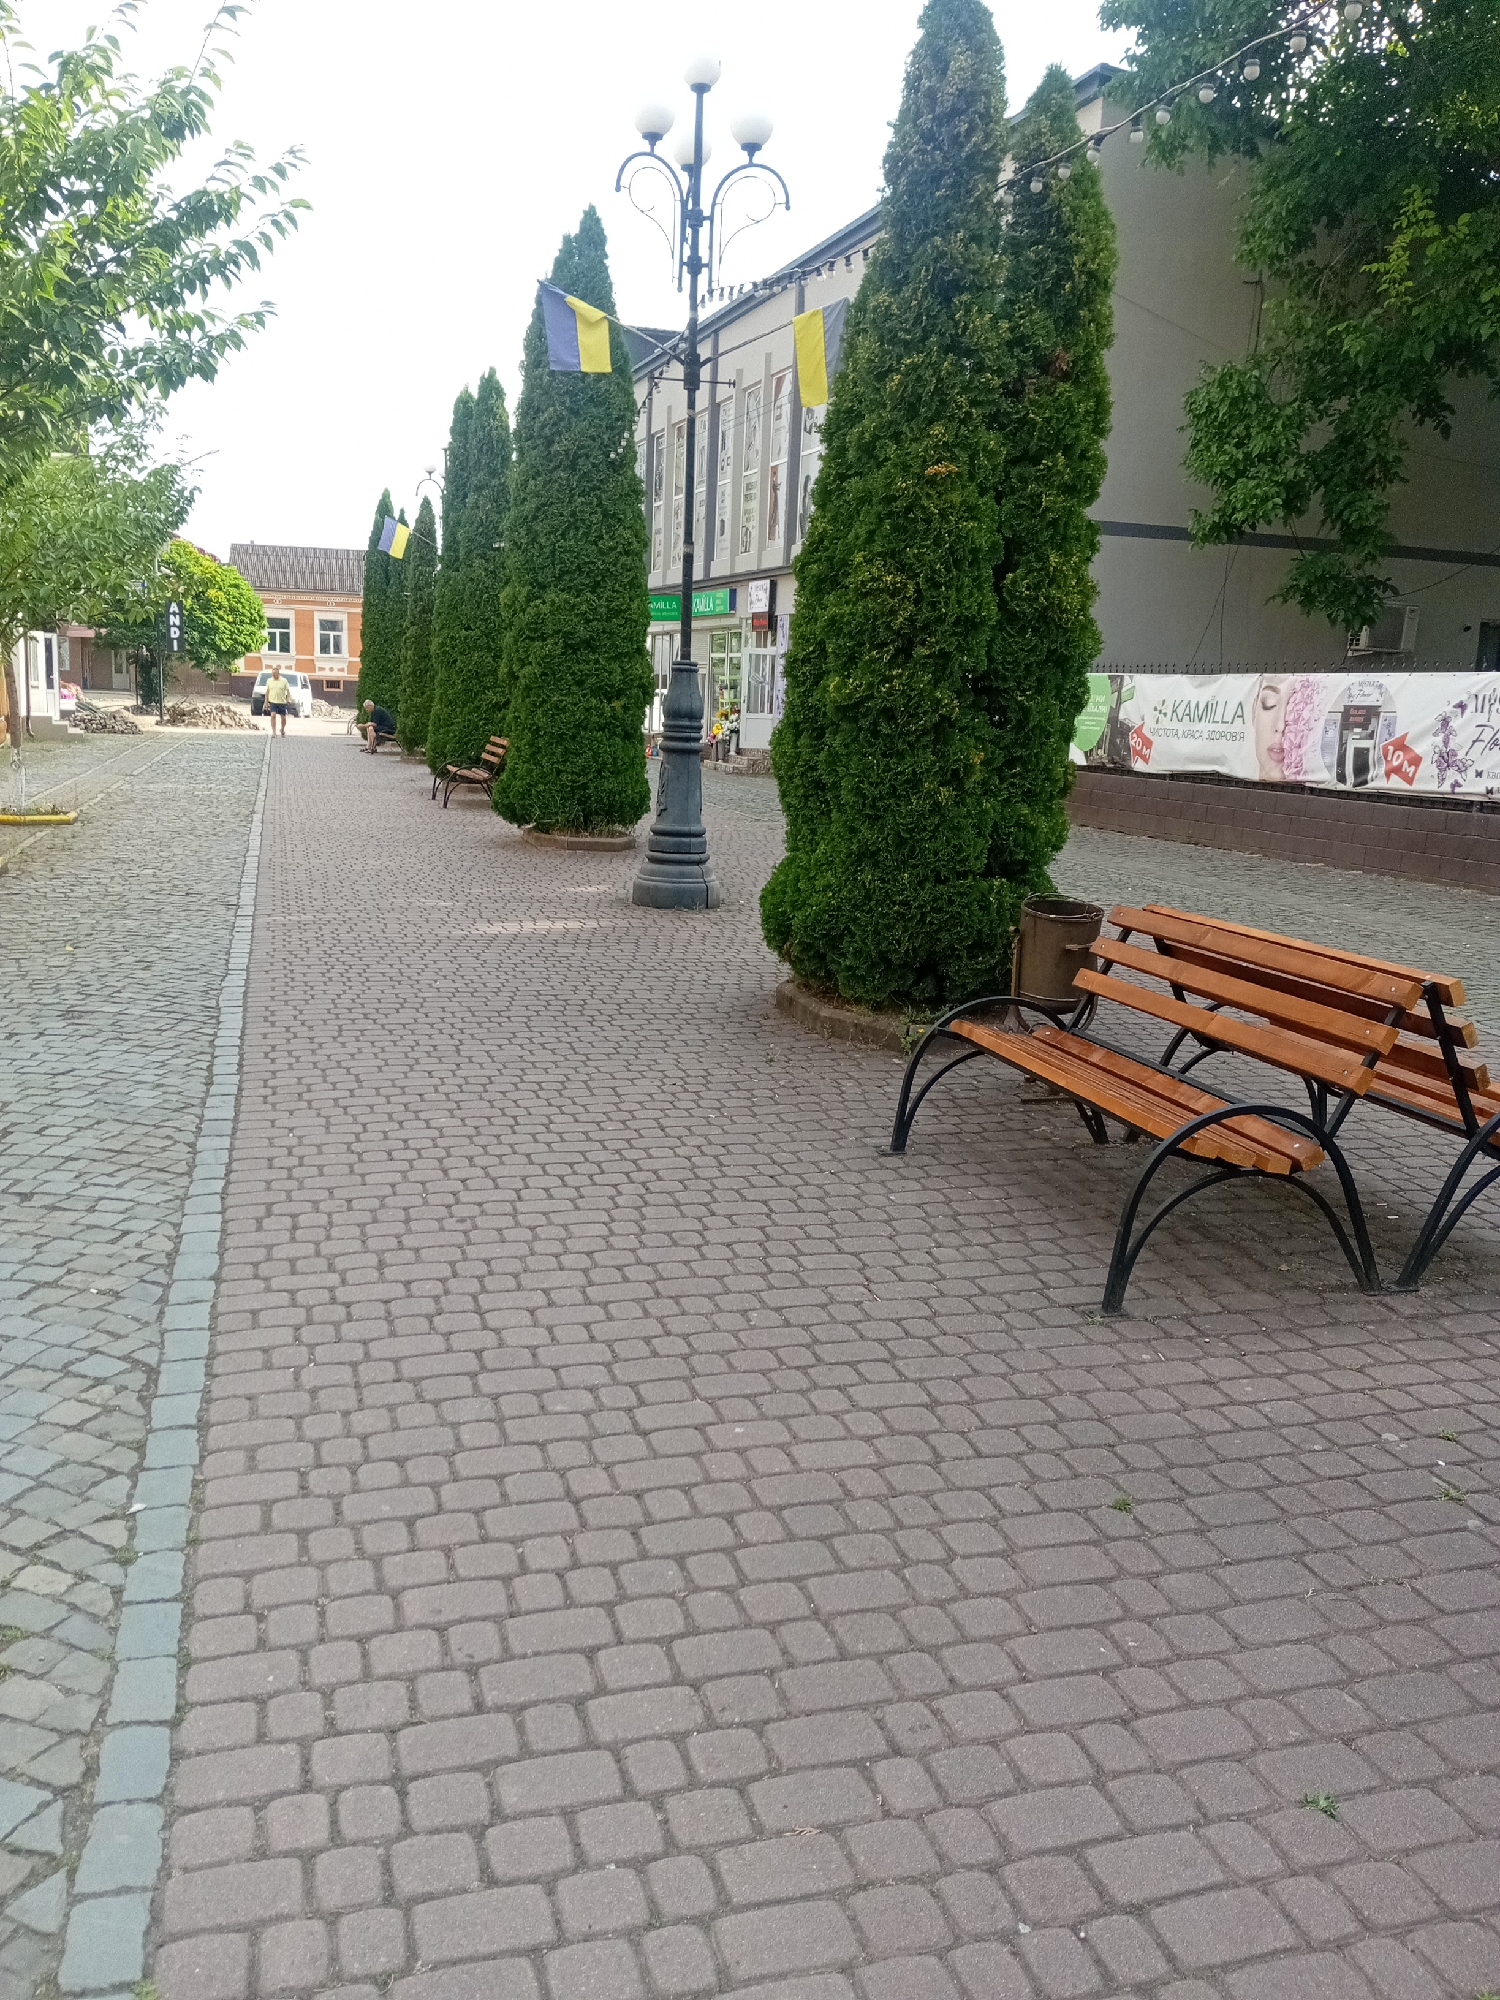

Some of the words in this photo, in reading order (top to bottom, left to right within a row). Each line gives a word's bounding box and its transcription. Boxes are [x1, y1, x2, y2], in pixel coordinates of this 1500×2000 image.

[169, 601, 181, 651] ANDI
[1131, 732, 1143, 751] 20
[1149, 727, 1180, 740] ЧИСТОТА,
[1465, 724, 1500, 757] Flo
[1386, 745, 1404, 767] 10
